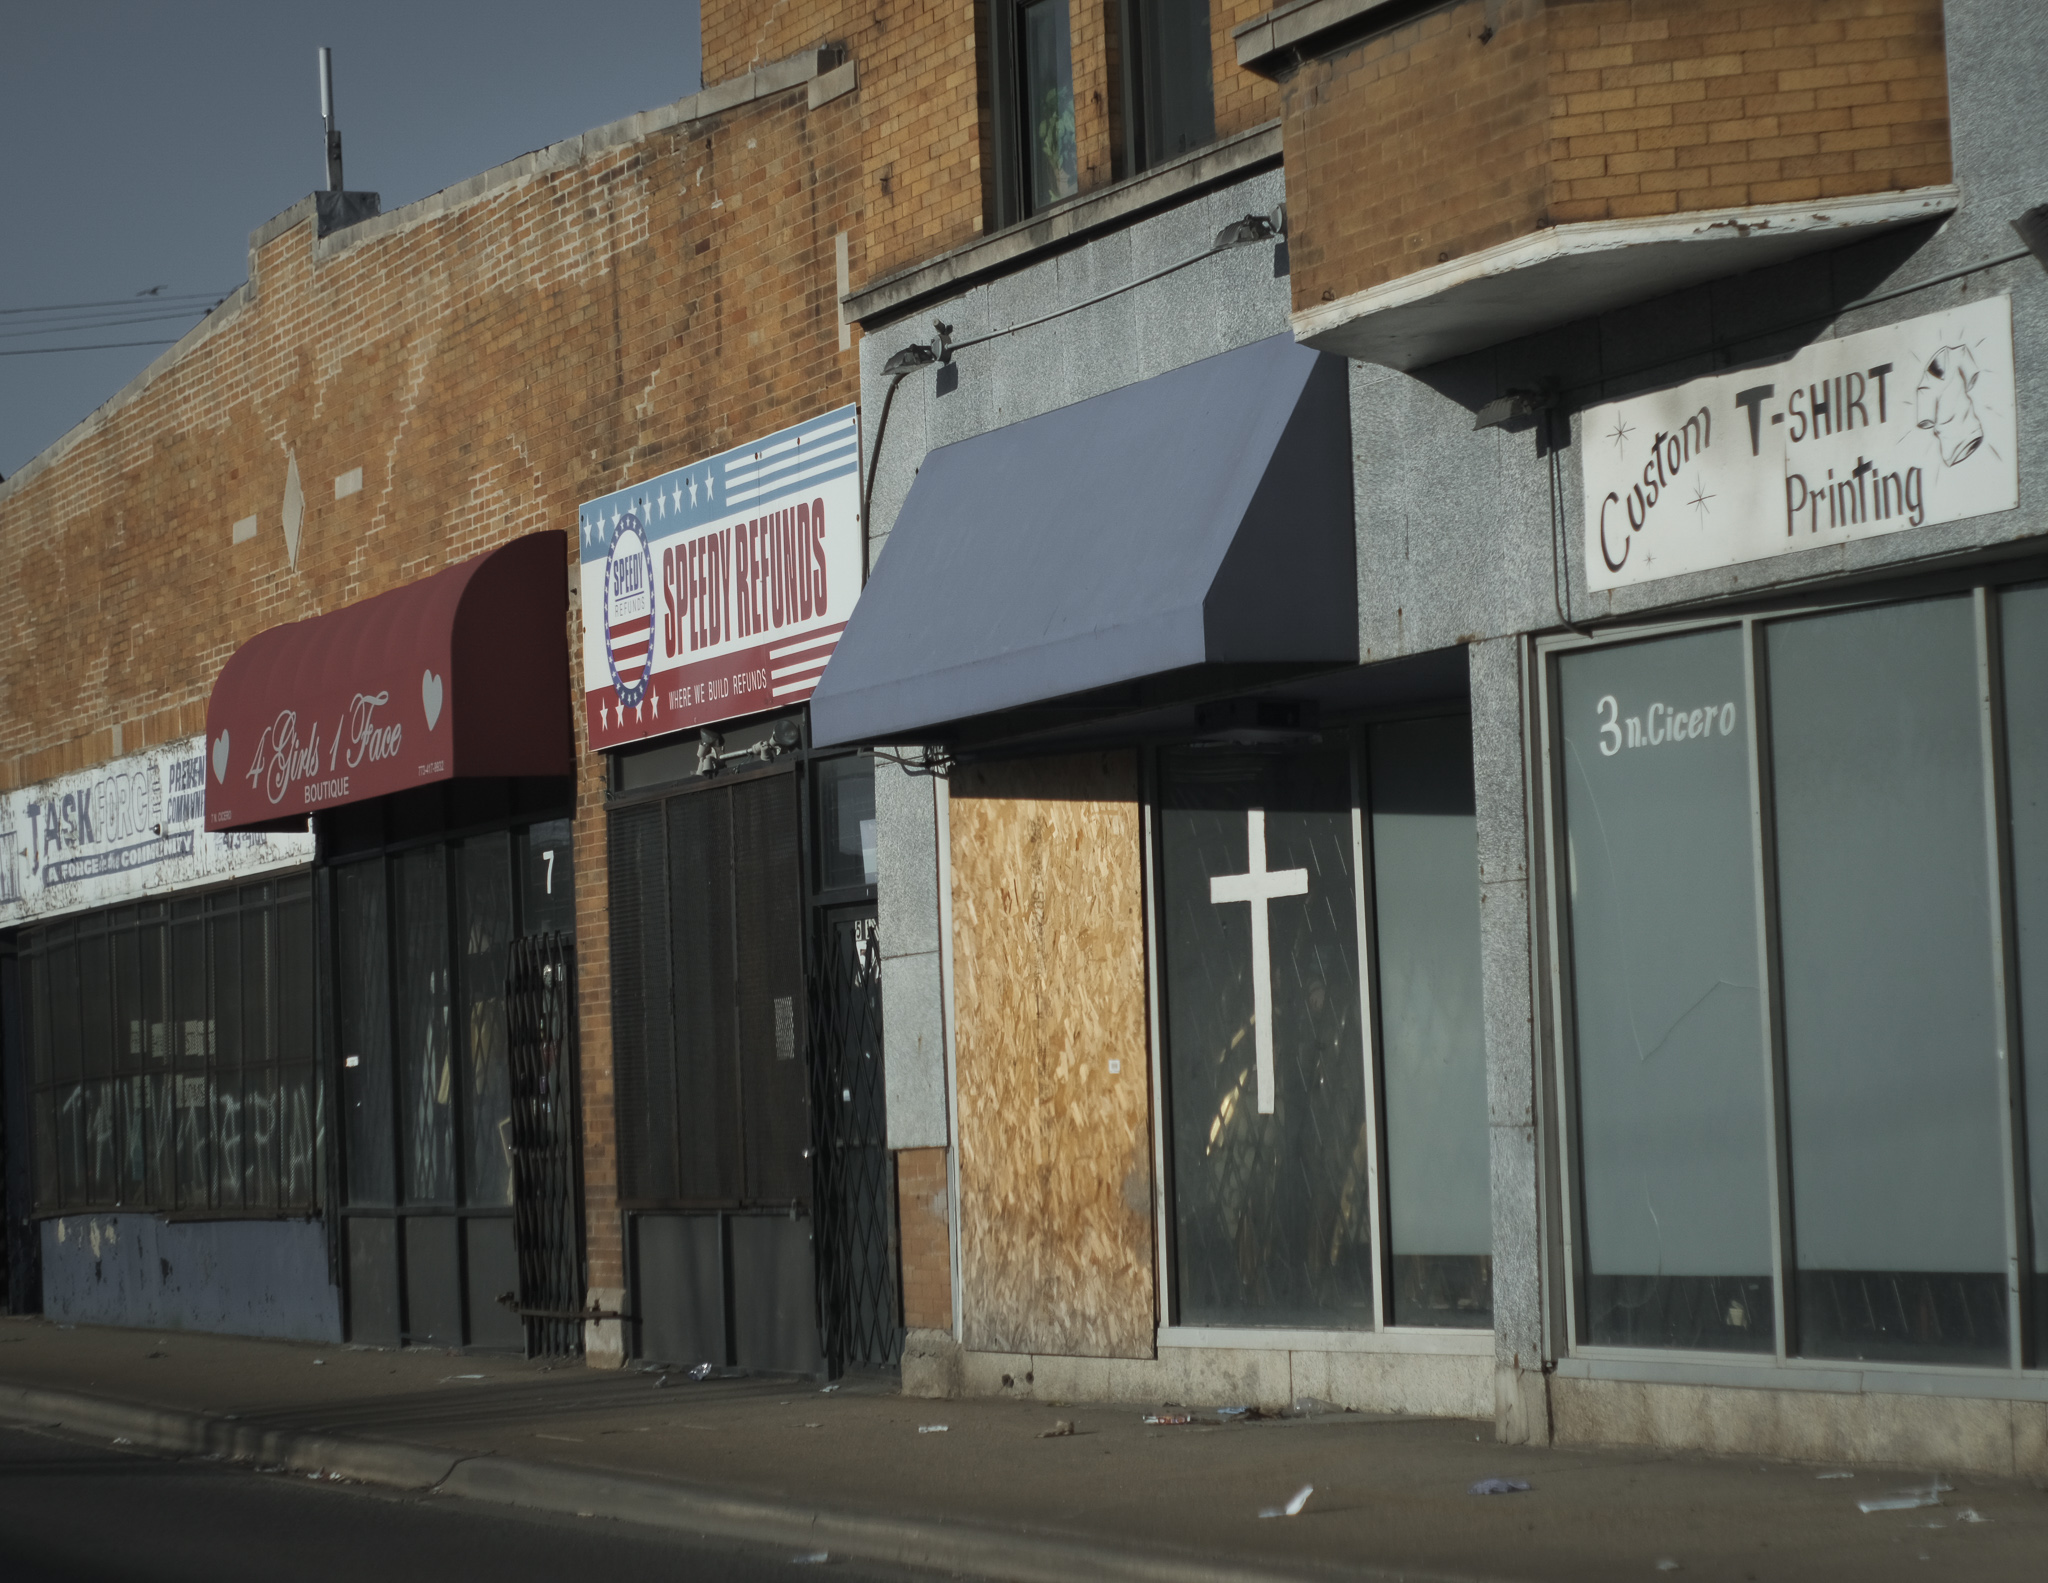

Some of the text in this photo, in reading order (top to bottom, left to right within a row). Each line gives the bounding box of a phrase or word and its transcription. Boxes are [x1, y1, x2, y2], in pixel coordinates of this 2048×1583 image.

[1600, 362, 1894, 574] Custom T-SHIRT
[1784, 455, 1925, 538] Printing
[613, 551, 644, 597] SPEEDY
[662, 497, 828, 659] SPEEDY REFUNDS
[614, 596, 646, 618] REFUNDS
[668, 668, 767, 711] WHERE WE BUILD REFUNDS
[245, 690, 402, 804] 4 Girls 1 Face
[1597, 694, 1623, 757] 3
[168, 754, 206, 794] PREVEN
[304, 776, 350, 804] BOUTIQUE
[27, 764, 162, 876] TASK FORCE
[166, 789, 206, 825] COMMUNI
[48, 866, 59, 883] A
[121, 834, 192, 867] COMMUNITY
[542, 850, 555, 894] 7
